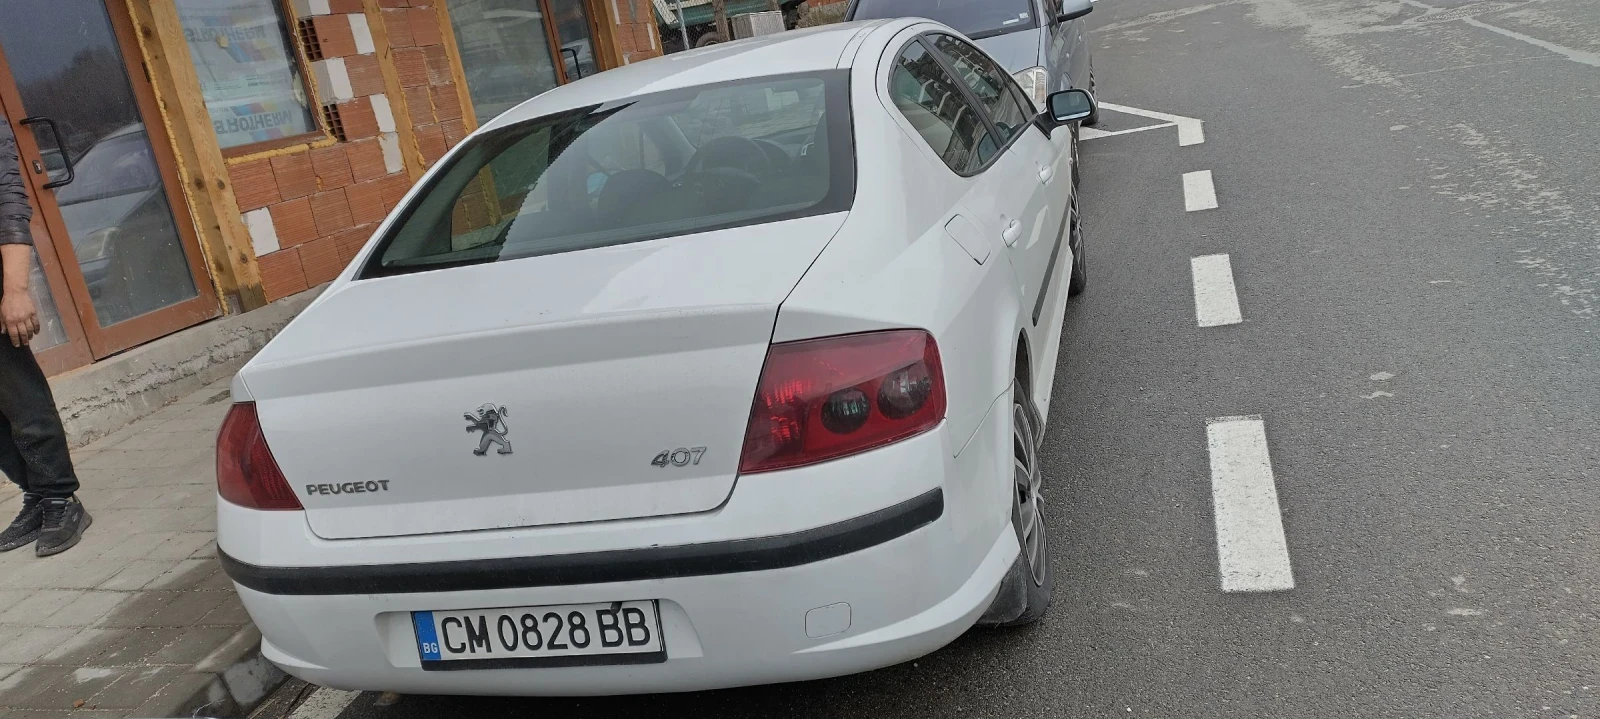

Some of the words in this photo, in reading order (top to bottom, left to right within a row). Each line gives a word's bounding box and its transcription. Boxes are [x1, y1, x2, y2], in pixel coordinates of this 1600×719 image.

[651, 446, 707, 468] 407
[306, 479, 389, 496] PEUGEOT
[441, 615, 492, 653] CM
[497, 611, 591, 651] 0828
[596, 607, 651, 648] BB
[423, 642, 438, 654] BG
